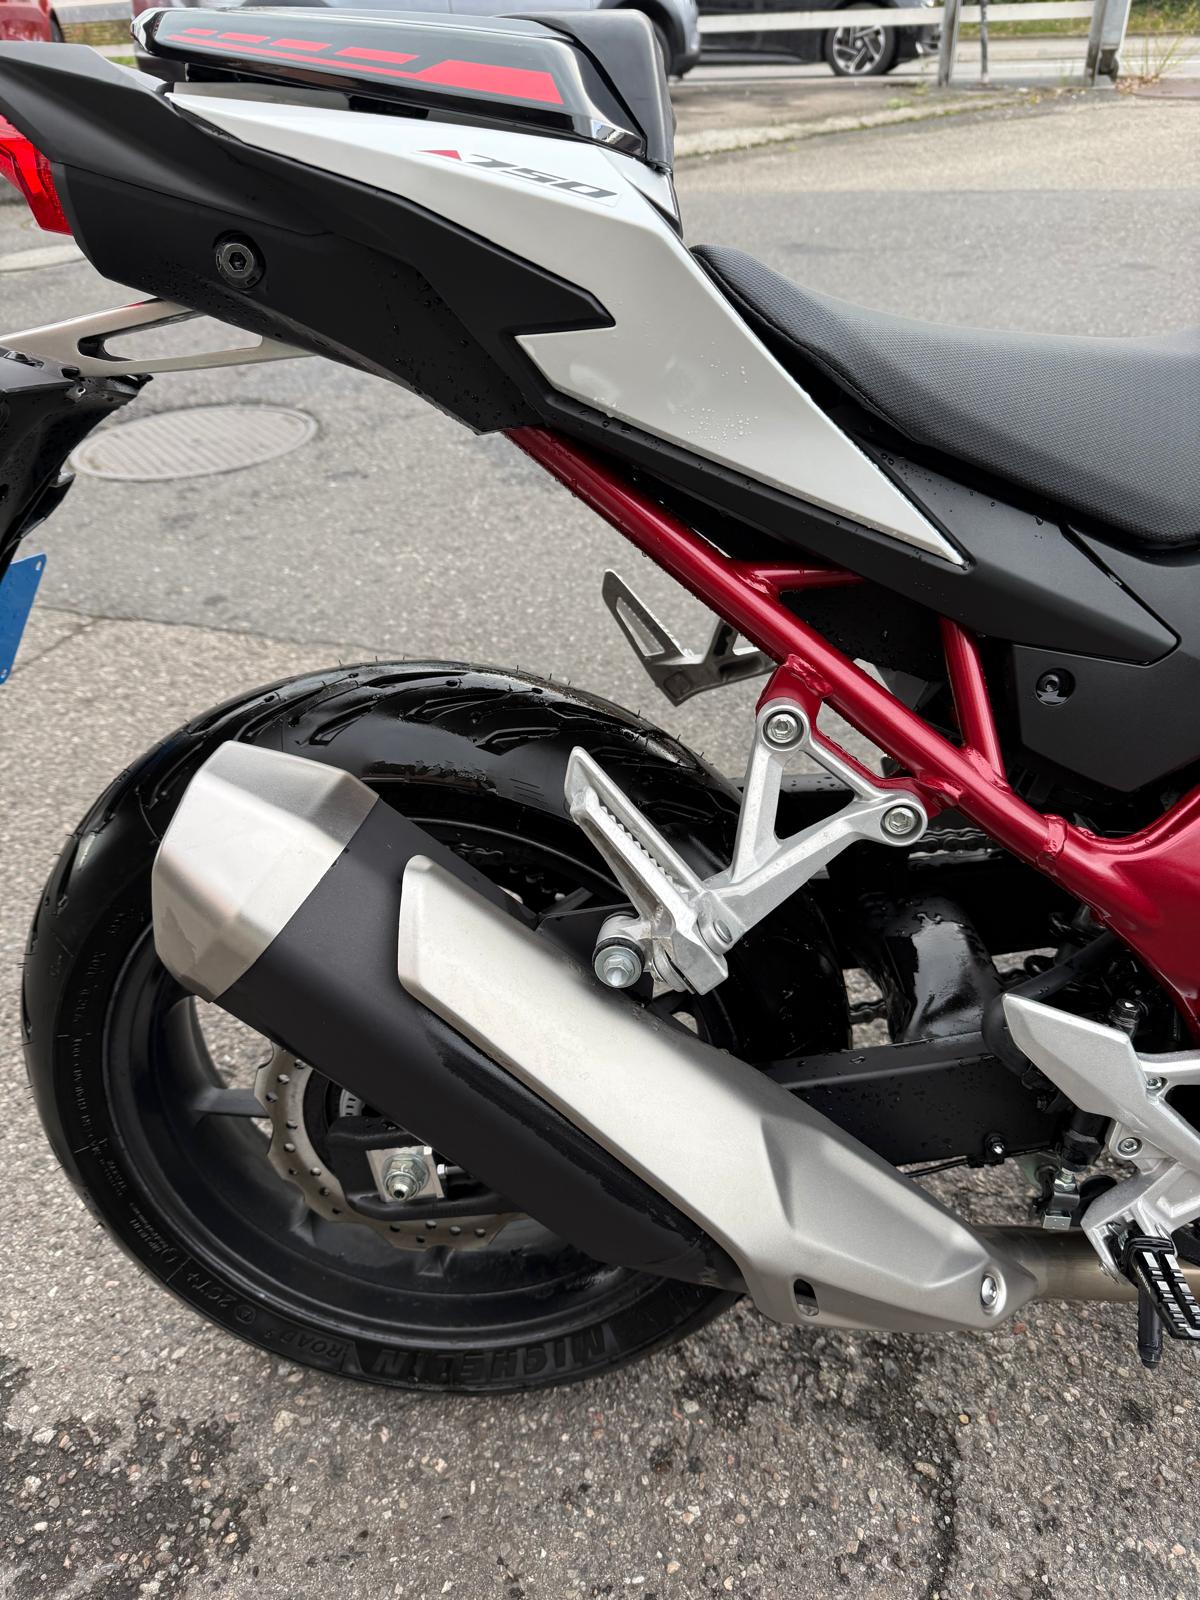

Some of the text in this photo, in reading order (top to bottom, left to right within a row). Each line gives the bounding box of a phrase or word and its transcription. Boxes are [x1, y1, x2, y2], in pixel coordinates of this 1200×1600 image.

[465, 153, 618, 198] 750
[279, 1329, 342, 1359] ROAD
[371, 1323, 609, 1385] MICHELIN
